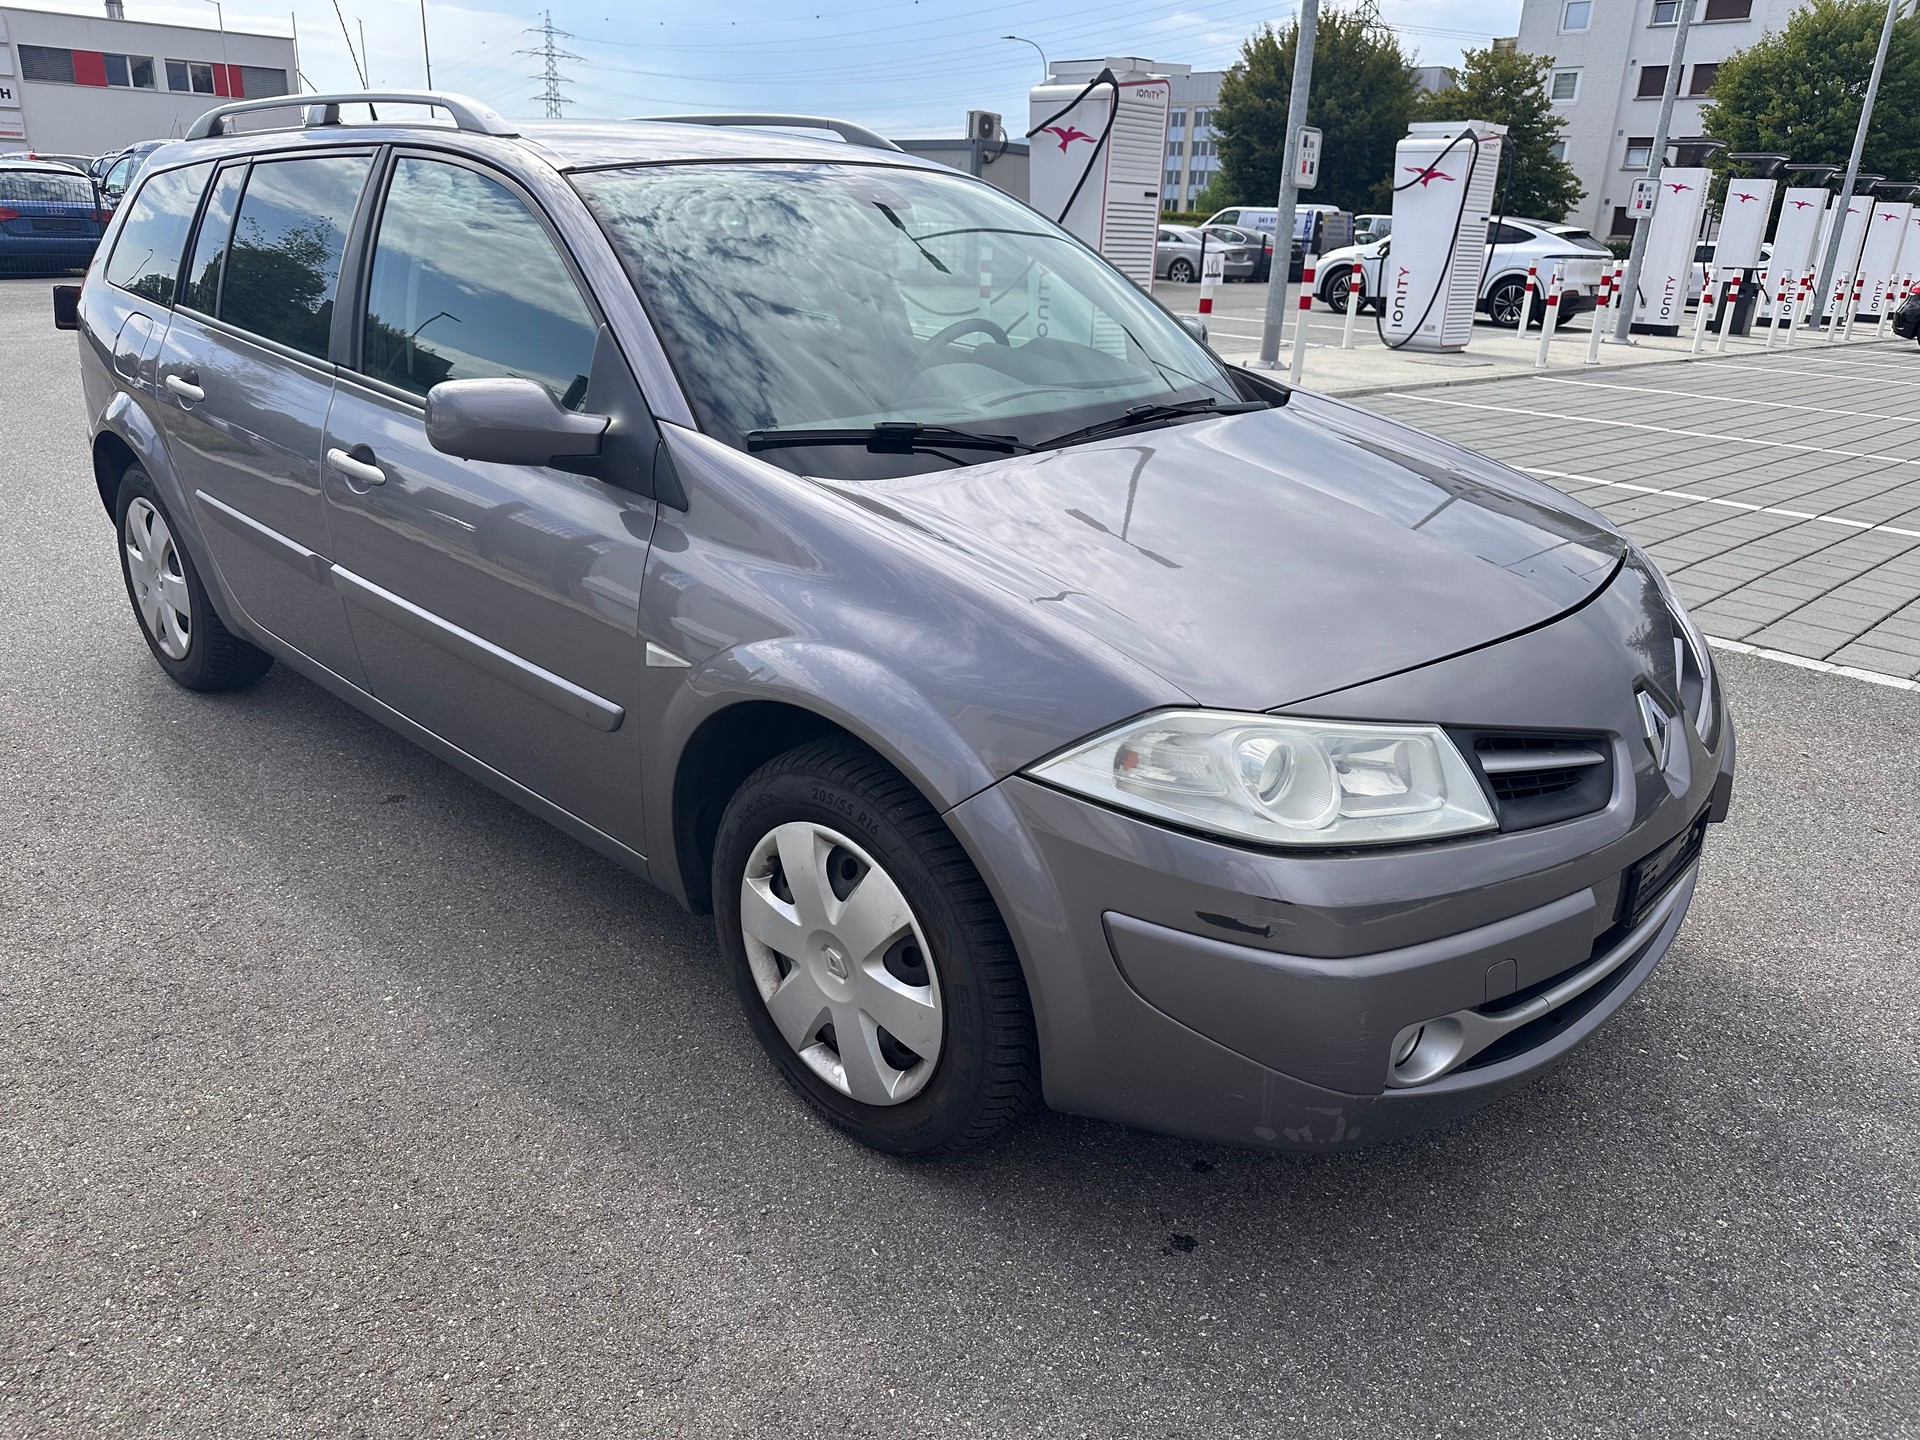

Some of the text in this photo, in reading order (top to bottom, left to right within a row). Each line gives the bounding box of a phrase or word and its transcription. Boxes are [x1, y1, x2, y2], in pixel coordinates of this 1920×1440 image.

[1136, 88, 1160, 99] IONITY
[1037, 265, 1050, 337] ONITY
[1391, 266, 1410, 328] IONITY
[1660, 275, 1677, 320] IONITY
[1782, 279, 1797, 315] IONITY
[1870, 279, 1884, 312] IONITY
[811, 787, 881, 836] 205/55 R16
